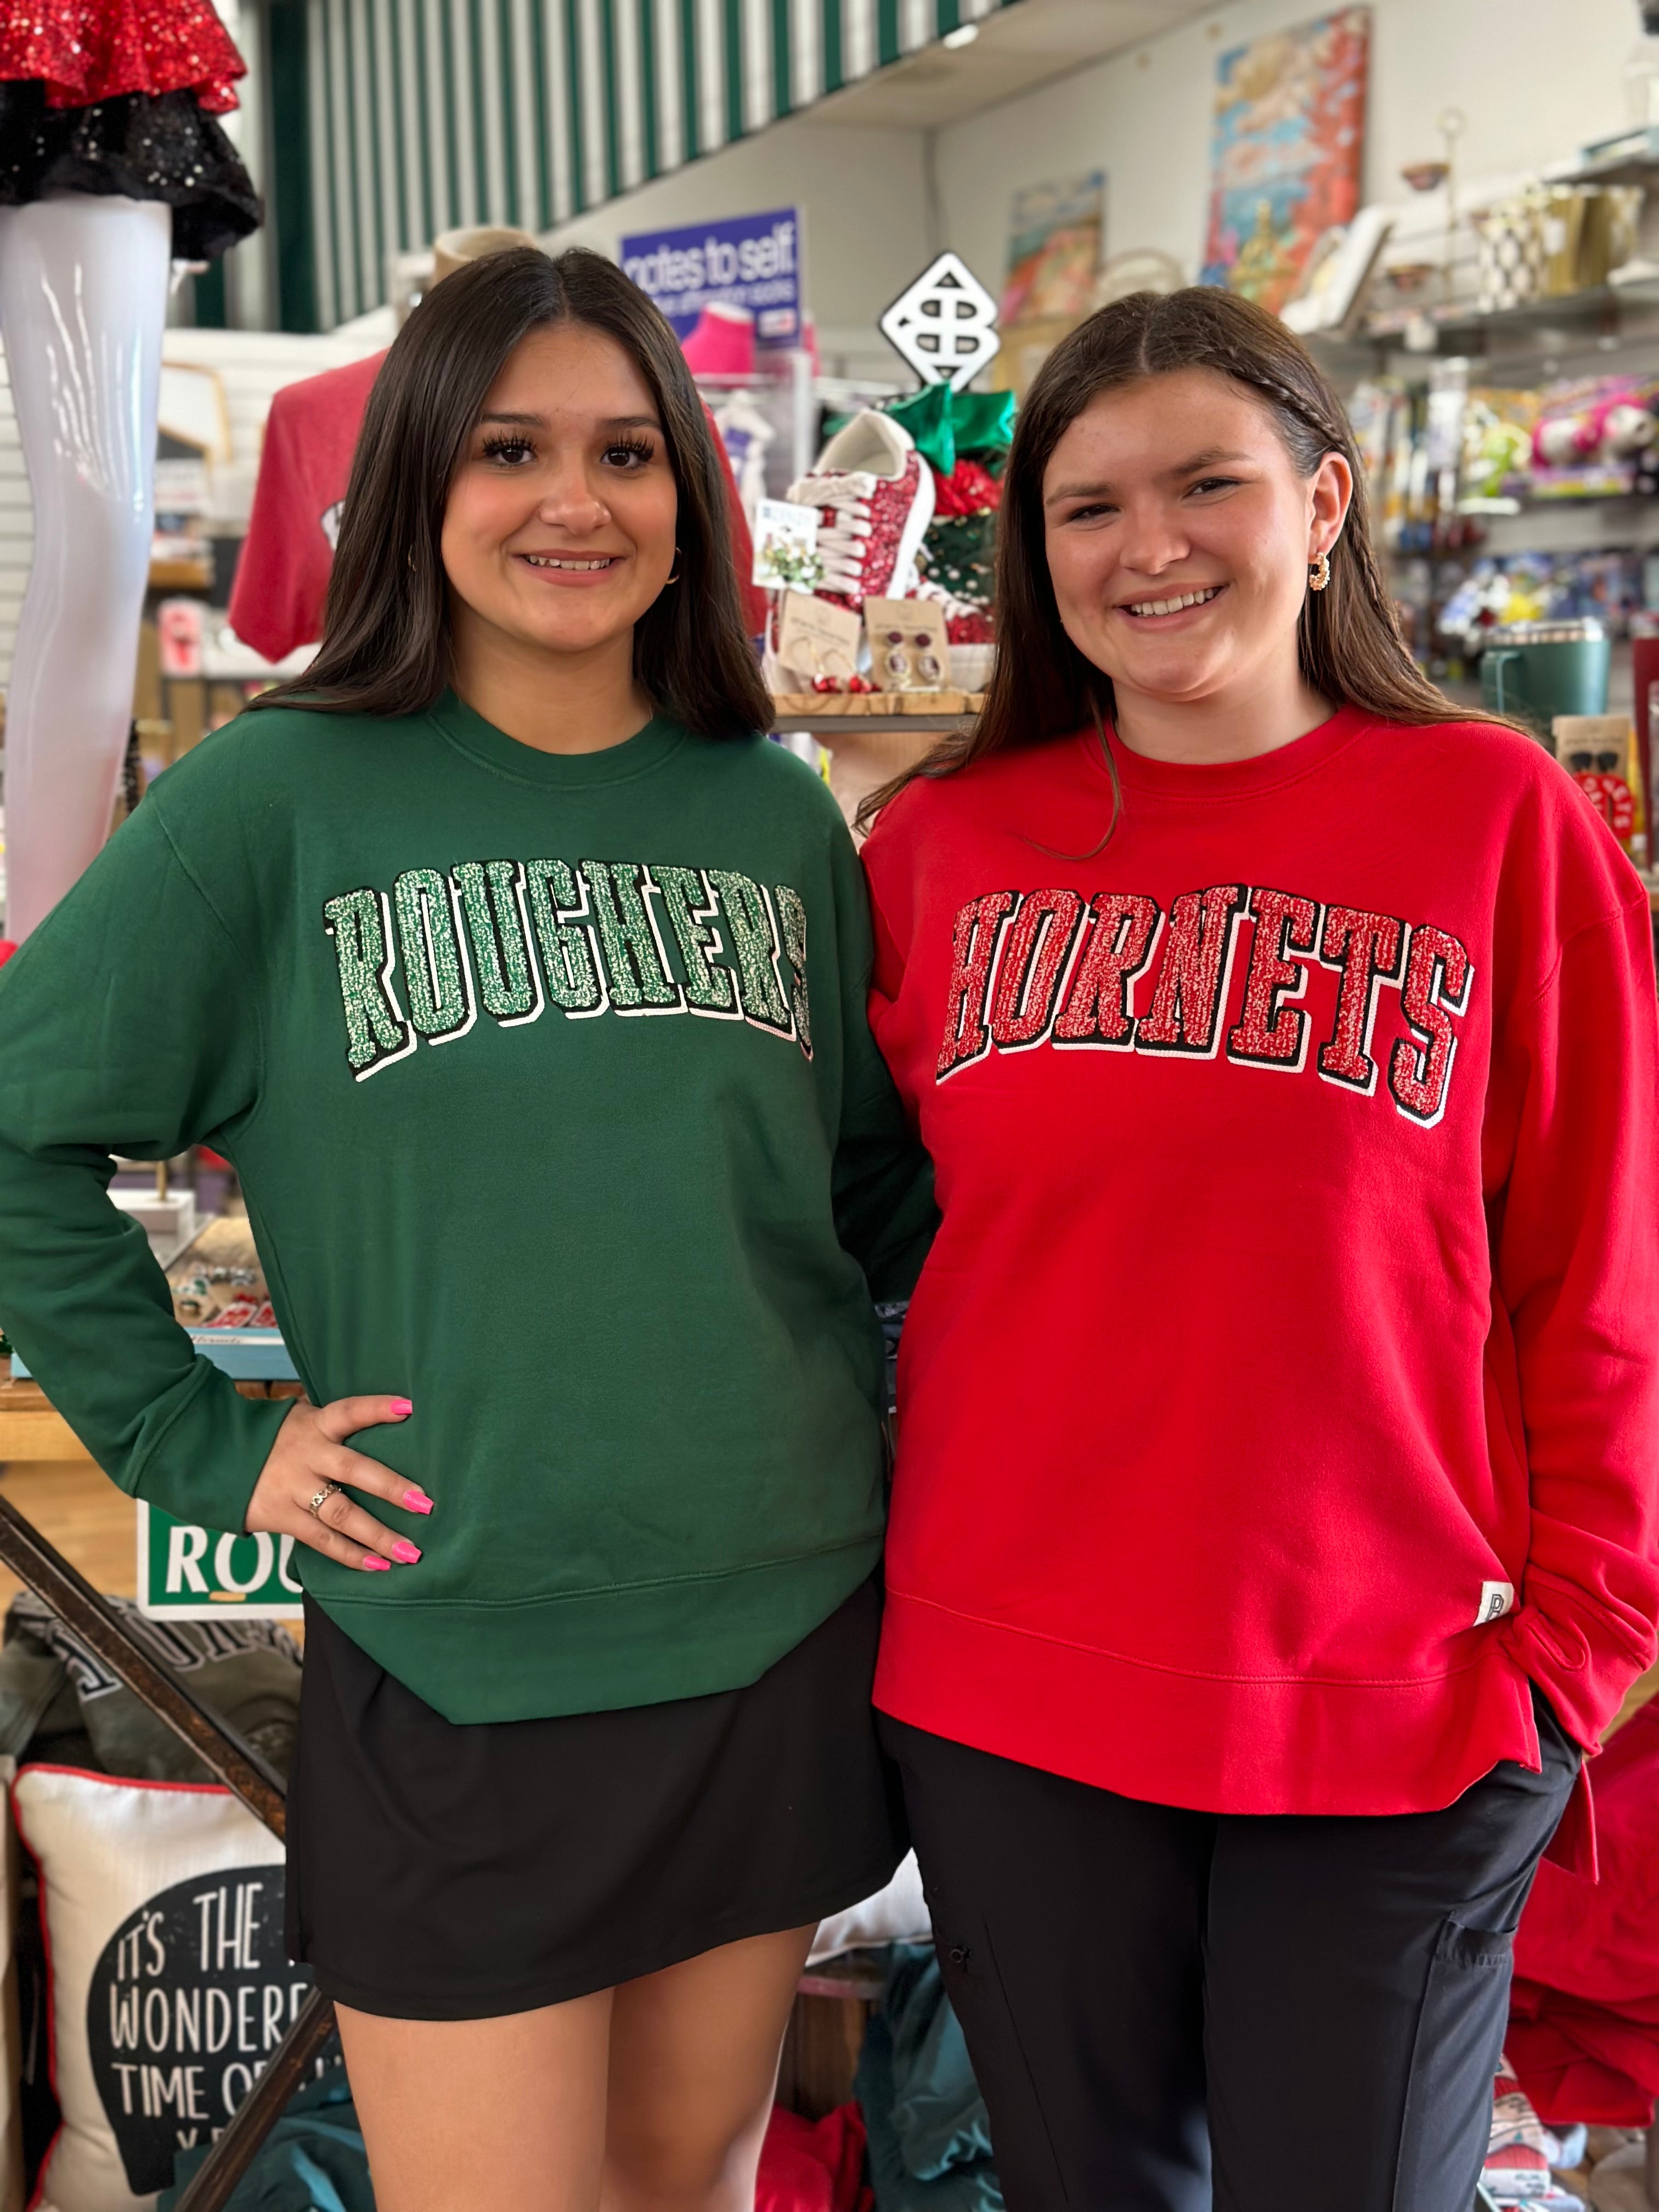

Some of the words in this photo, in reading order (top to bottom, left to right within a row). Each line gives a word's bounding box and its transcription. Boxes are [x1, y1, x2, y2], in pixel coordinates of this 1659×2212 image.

[704, 236, 737, 286] to
[323, 858, 813, 1082] ROUGHERS
[936, 883, 1475, 1129] HORNETS
[117, 1910, 166, 1982] IT'S
[193, 1882, 264, 1972] THE
[111, 2062, 210, 2120] TIME
[222, 2061, 268, 2117] O
